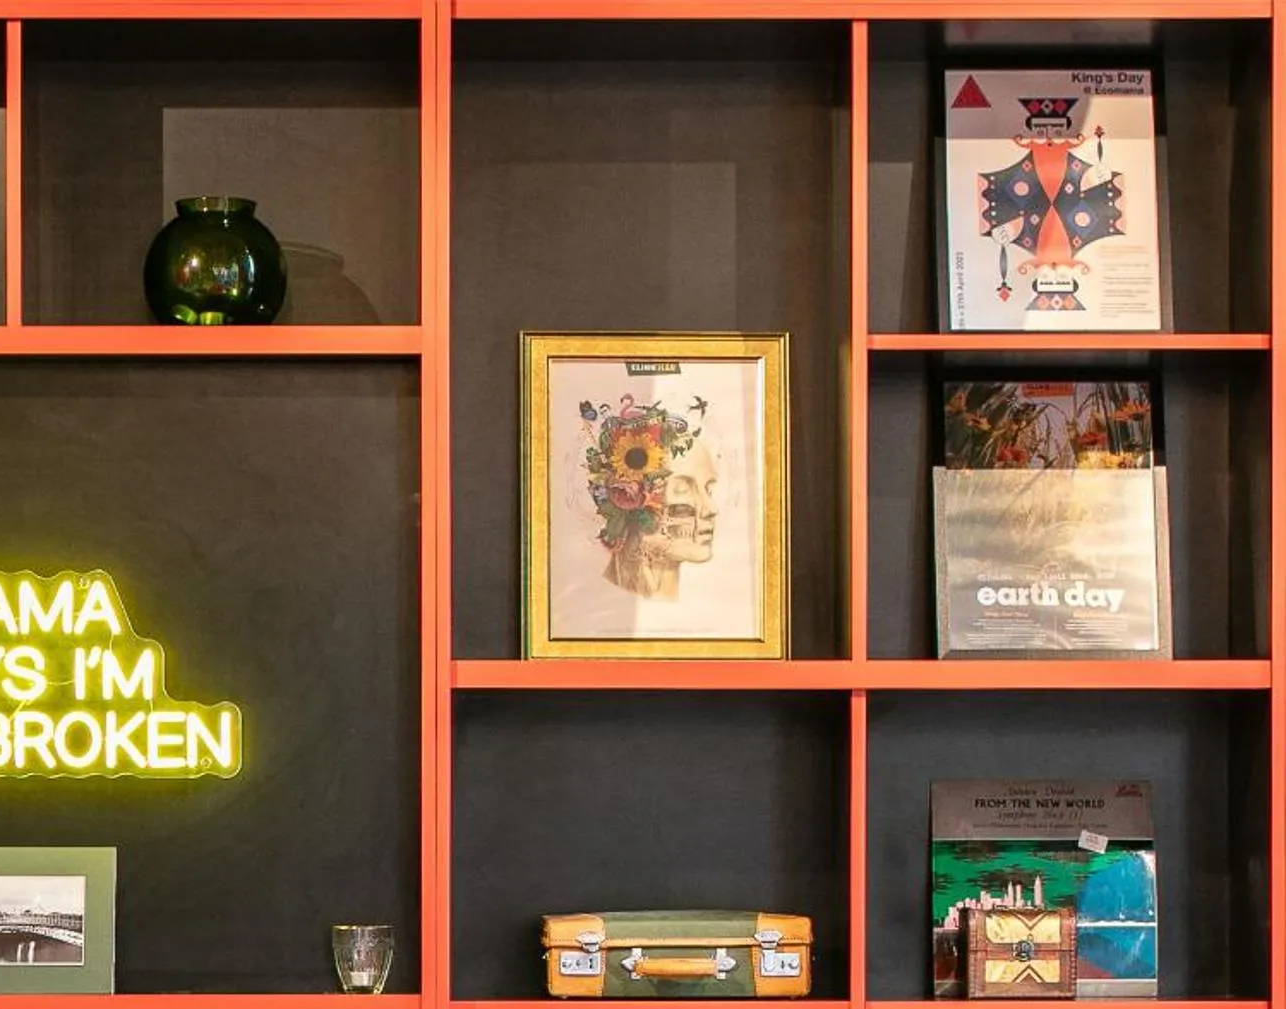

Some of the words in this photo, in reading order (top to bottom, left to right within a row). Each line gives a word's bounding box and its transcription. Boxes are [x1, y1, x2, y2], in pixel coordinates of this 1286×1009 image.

[1071, 71, 1114, 84] King's
[1117, 71, 1145, 85] Day
[977, 581, 1060, 606] earth
[1064, 580, 1125, 612] day
[74, 645, 155, 701] I'M
[974, 799, 1008, 809] FROM
[1012, 799, 1031, 809] THE
[1036, 799, 1060, 809] NEW
[1066, 799, 1105, 809] WORLD
